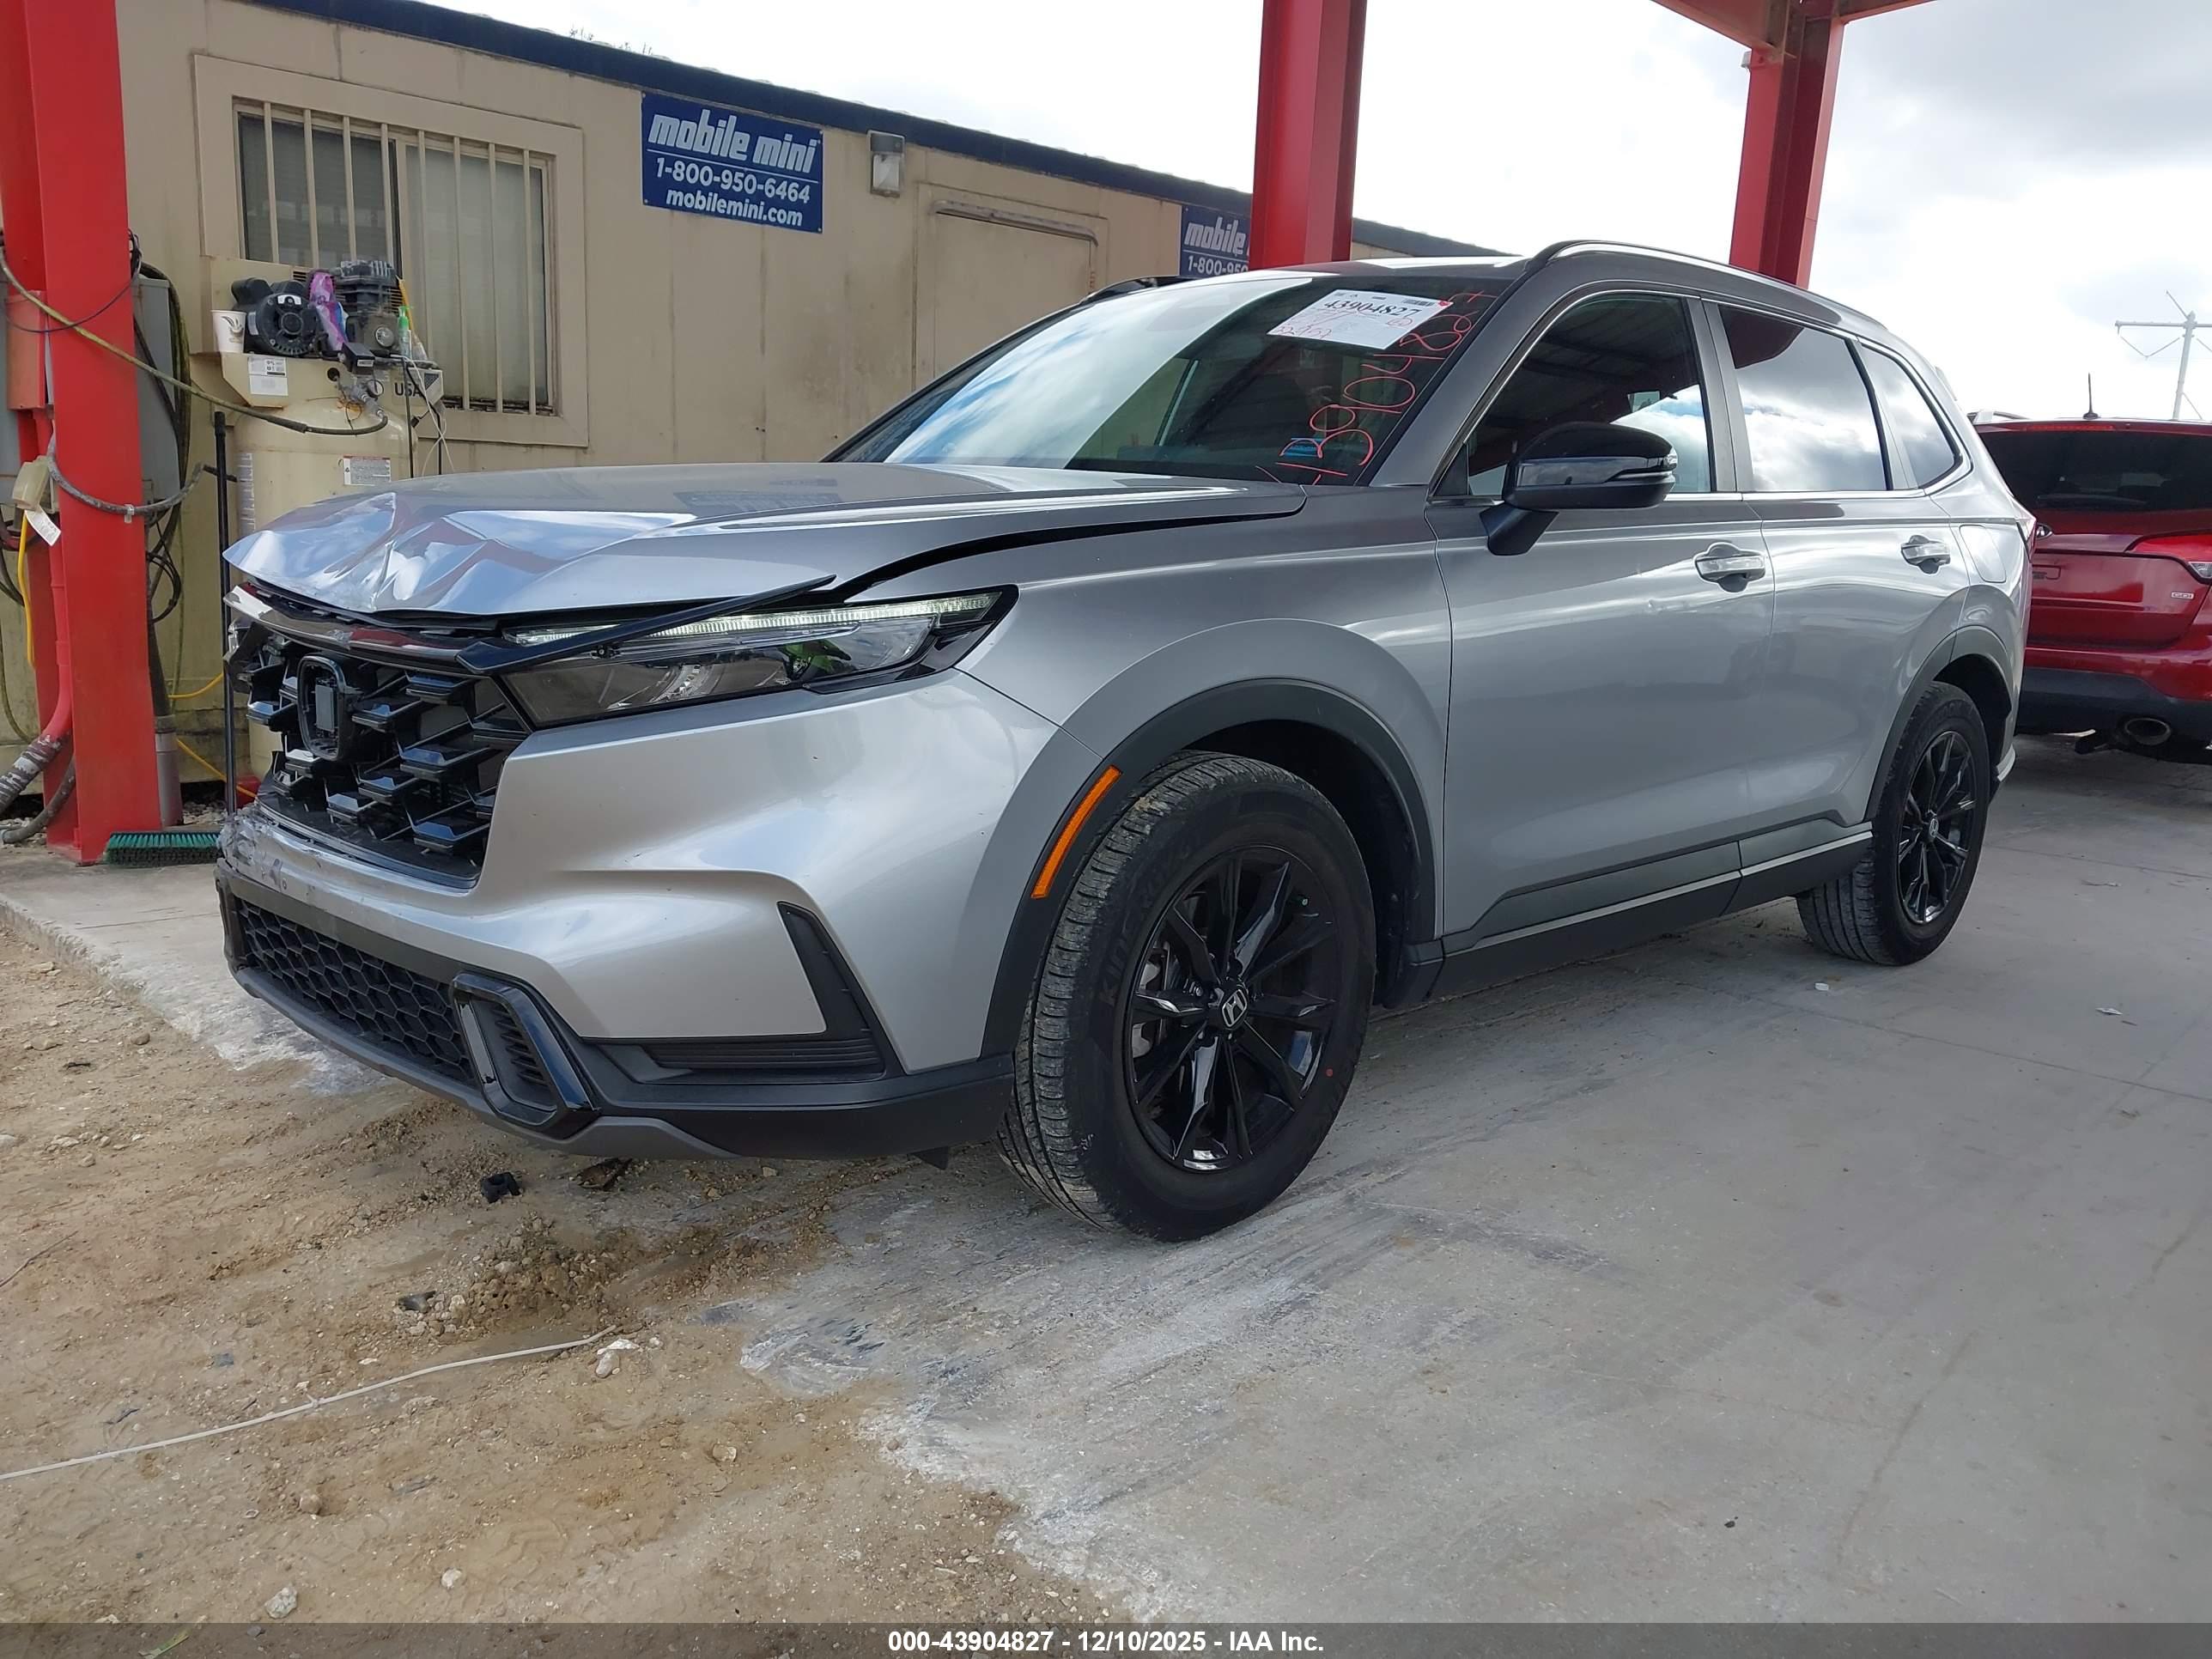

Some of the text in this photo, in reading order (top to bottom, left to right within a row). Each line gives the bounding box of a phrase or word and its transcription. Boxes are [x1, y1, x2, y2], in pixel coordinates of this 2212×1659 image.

[648, 109, 817, 173] mobile mini
[656, 157, 811, 204] 1-800-950-6464
[665, 189, 804, 227] mobilemini.com
[1183, 216, 1247, 255] mobile
[1324, 300, 1422, 318] 43904827
